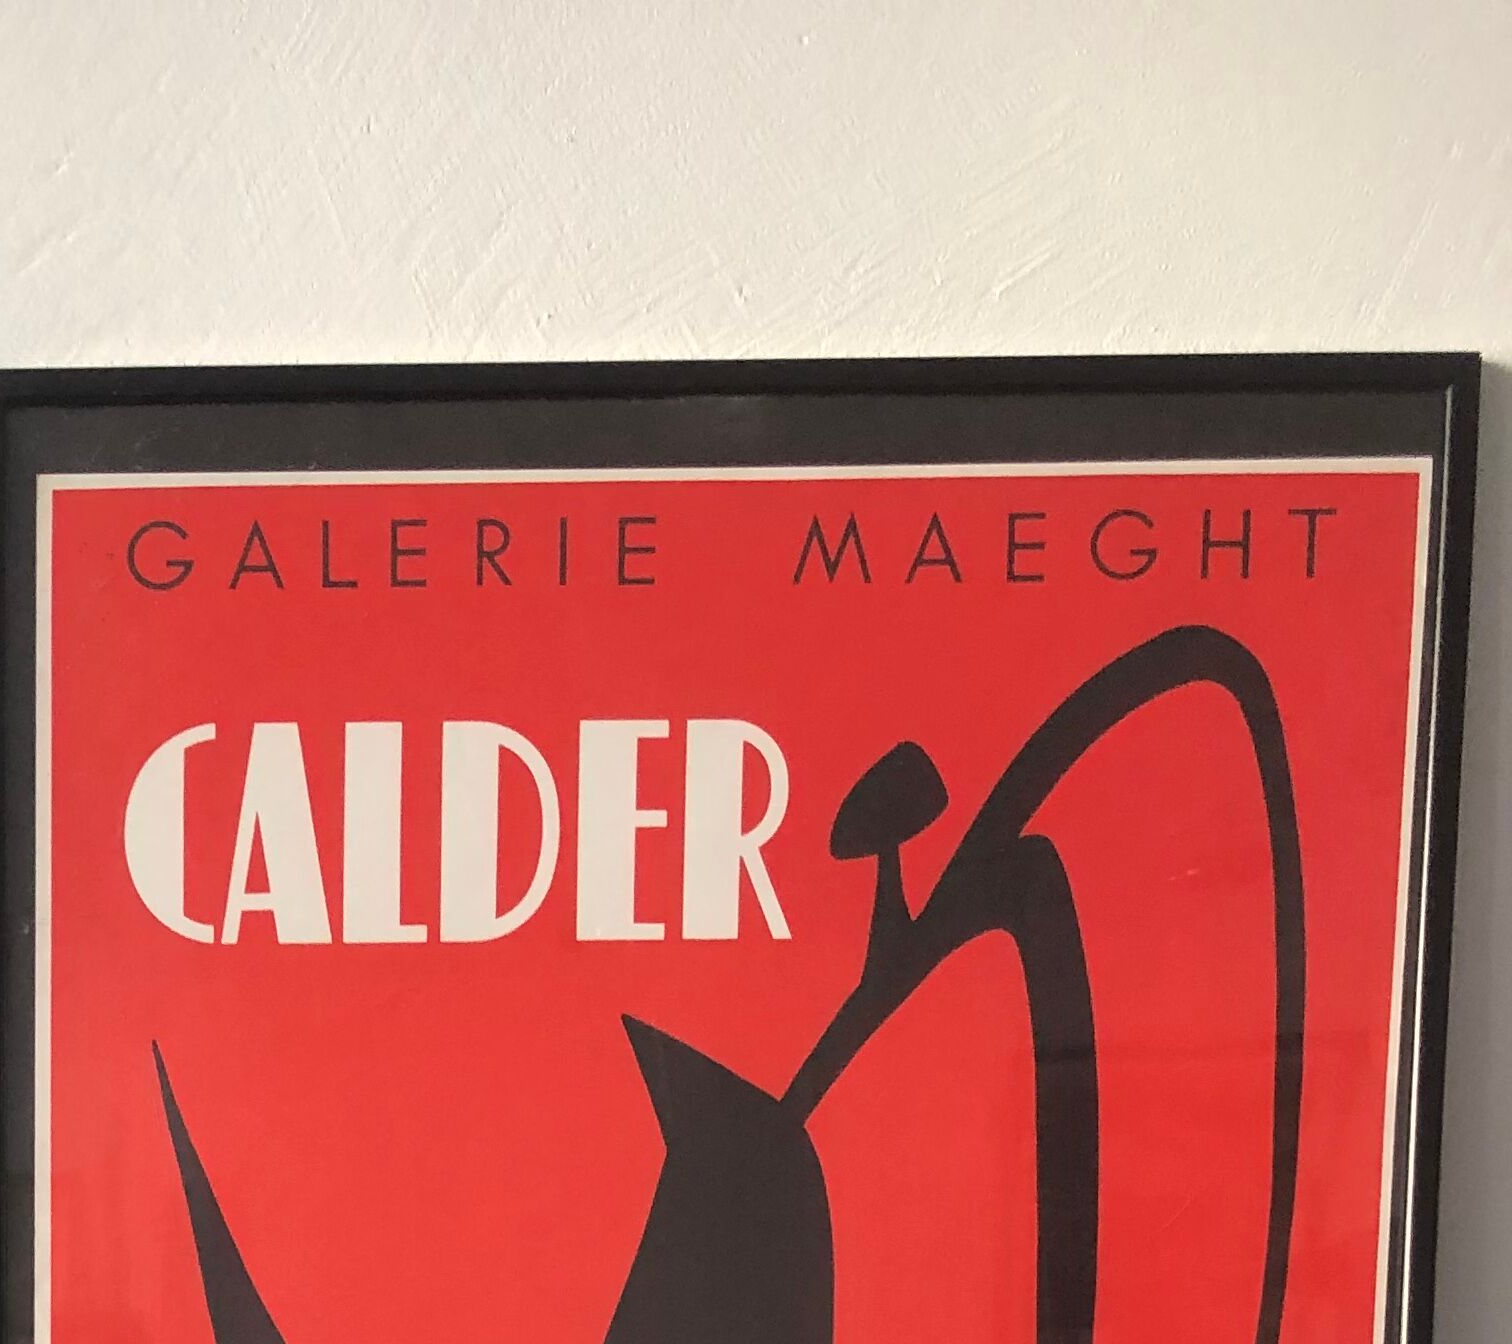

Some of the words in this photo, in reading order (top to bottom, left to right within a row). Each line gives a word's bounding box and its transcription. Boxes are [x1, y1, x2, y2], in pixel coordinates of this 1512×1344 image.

[126, 516, 658, 591] GALERIE
[792, 507, 1338, 585] MAEGHT
[123, 718, 792, 945] CALDER
